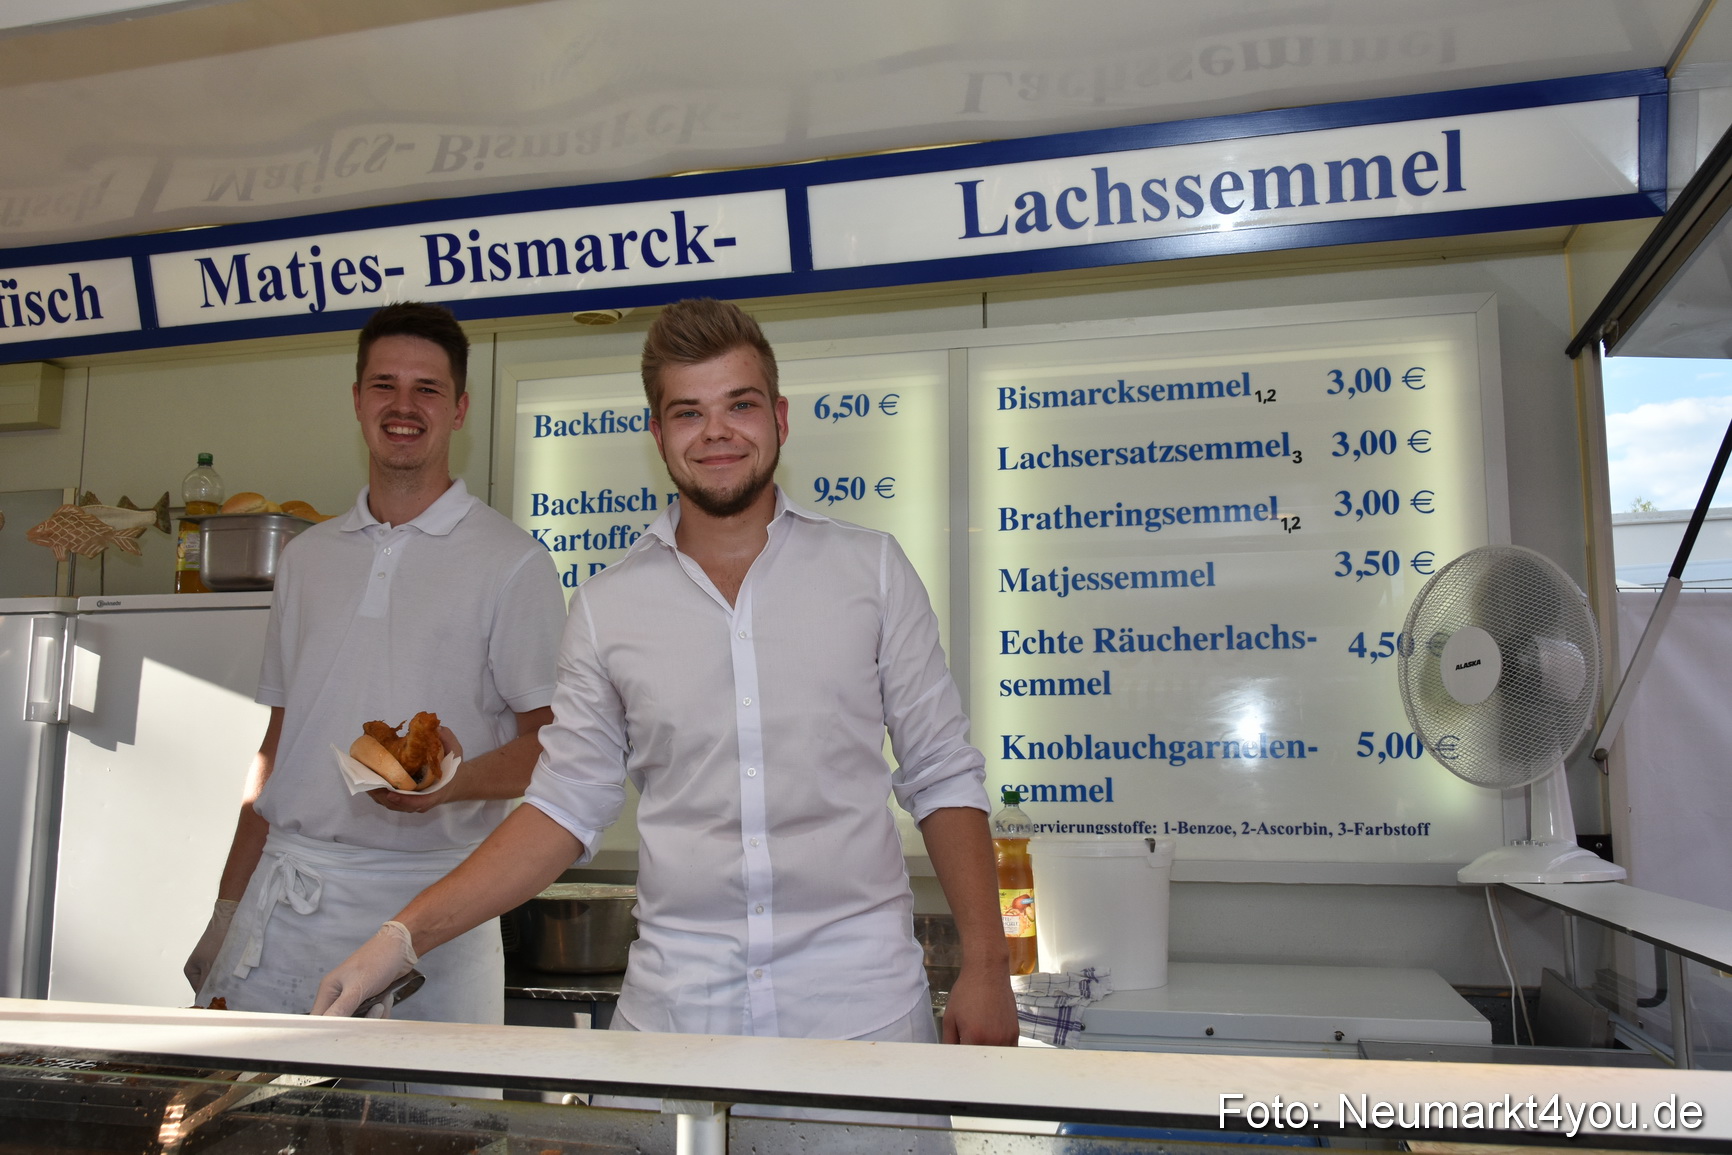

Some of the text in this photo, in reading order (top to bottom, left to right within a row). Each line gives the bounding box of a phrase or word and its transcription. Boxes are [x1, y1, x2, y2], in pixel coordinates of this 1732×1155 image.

[955, 130, 1466, 240] Lachssemmel
[195, 210, 737, 313] Matjes- Bismarck-
[814, 393, 870, 423] 6,50
[878, 393, 900, 416] €
[997, 372, 1251, 411] Bismarcksemmel
[1326, 367, 1392, 399] 3,00
[1402, 367, 1426, 390] €
[997, 432, 1291, 471] Lachsersatzsemmel
[1331, 430, 1397, 462] 3,00
[1407, 429, 1432, 454] €
[531, 487, 657, 517] Backfisch
[813, 476, 866, 506] 9,50
[874, 476, 896, 499] €
[998, 496, 1279, 532] Bratheringsemmel
[1334, 490, 1400, 521] 3,00
[1410, 490, 1435, 514] €
[530, 524, 650, 552] Kartoffe
[998, 550, 1435, 598] Matjessemmel 3,50 €
[1000, 629, 1084, 655] Echte
[1093, 624, 1318, 654] Räucherlachs-
[1348, 631, 1415, 664] 4,50
[1000, 670, 1111, 698] semmel
[1455, 659, 1482, 671] ALASKA
[1001, 733, 1318, 767] Knoblauchgarnelen-
[1356, 731, 1424, 764] 5,00
[1163, 821, 1237, 838] 1-Benzoe,
[1241, 821, 1333, 838] 2-Ascorbin,
[1338, 821, 1431, 837] 3-Farbstoff
